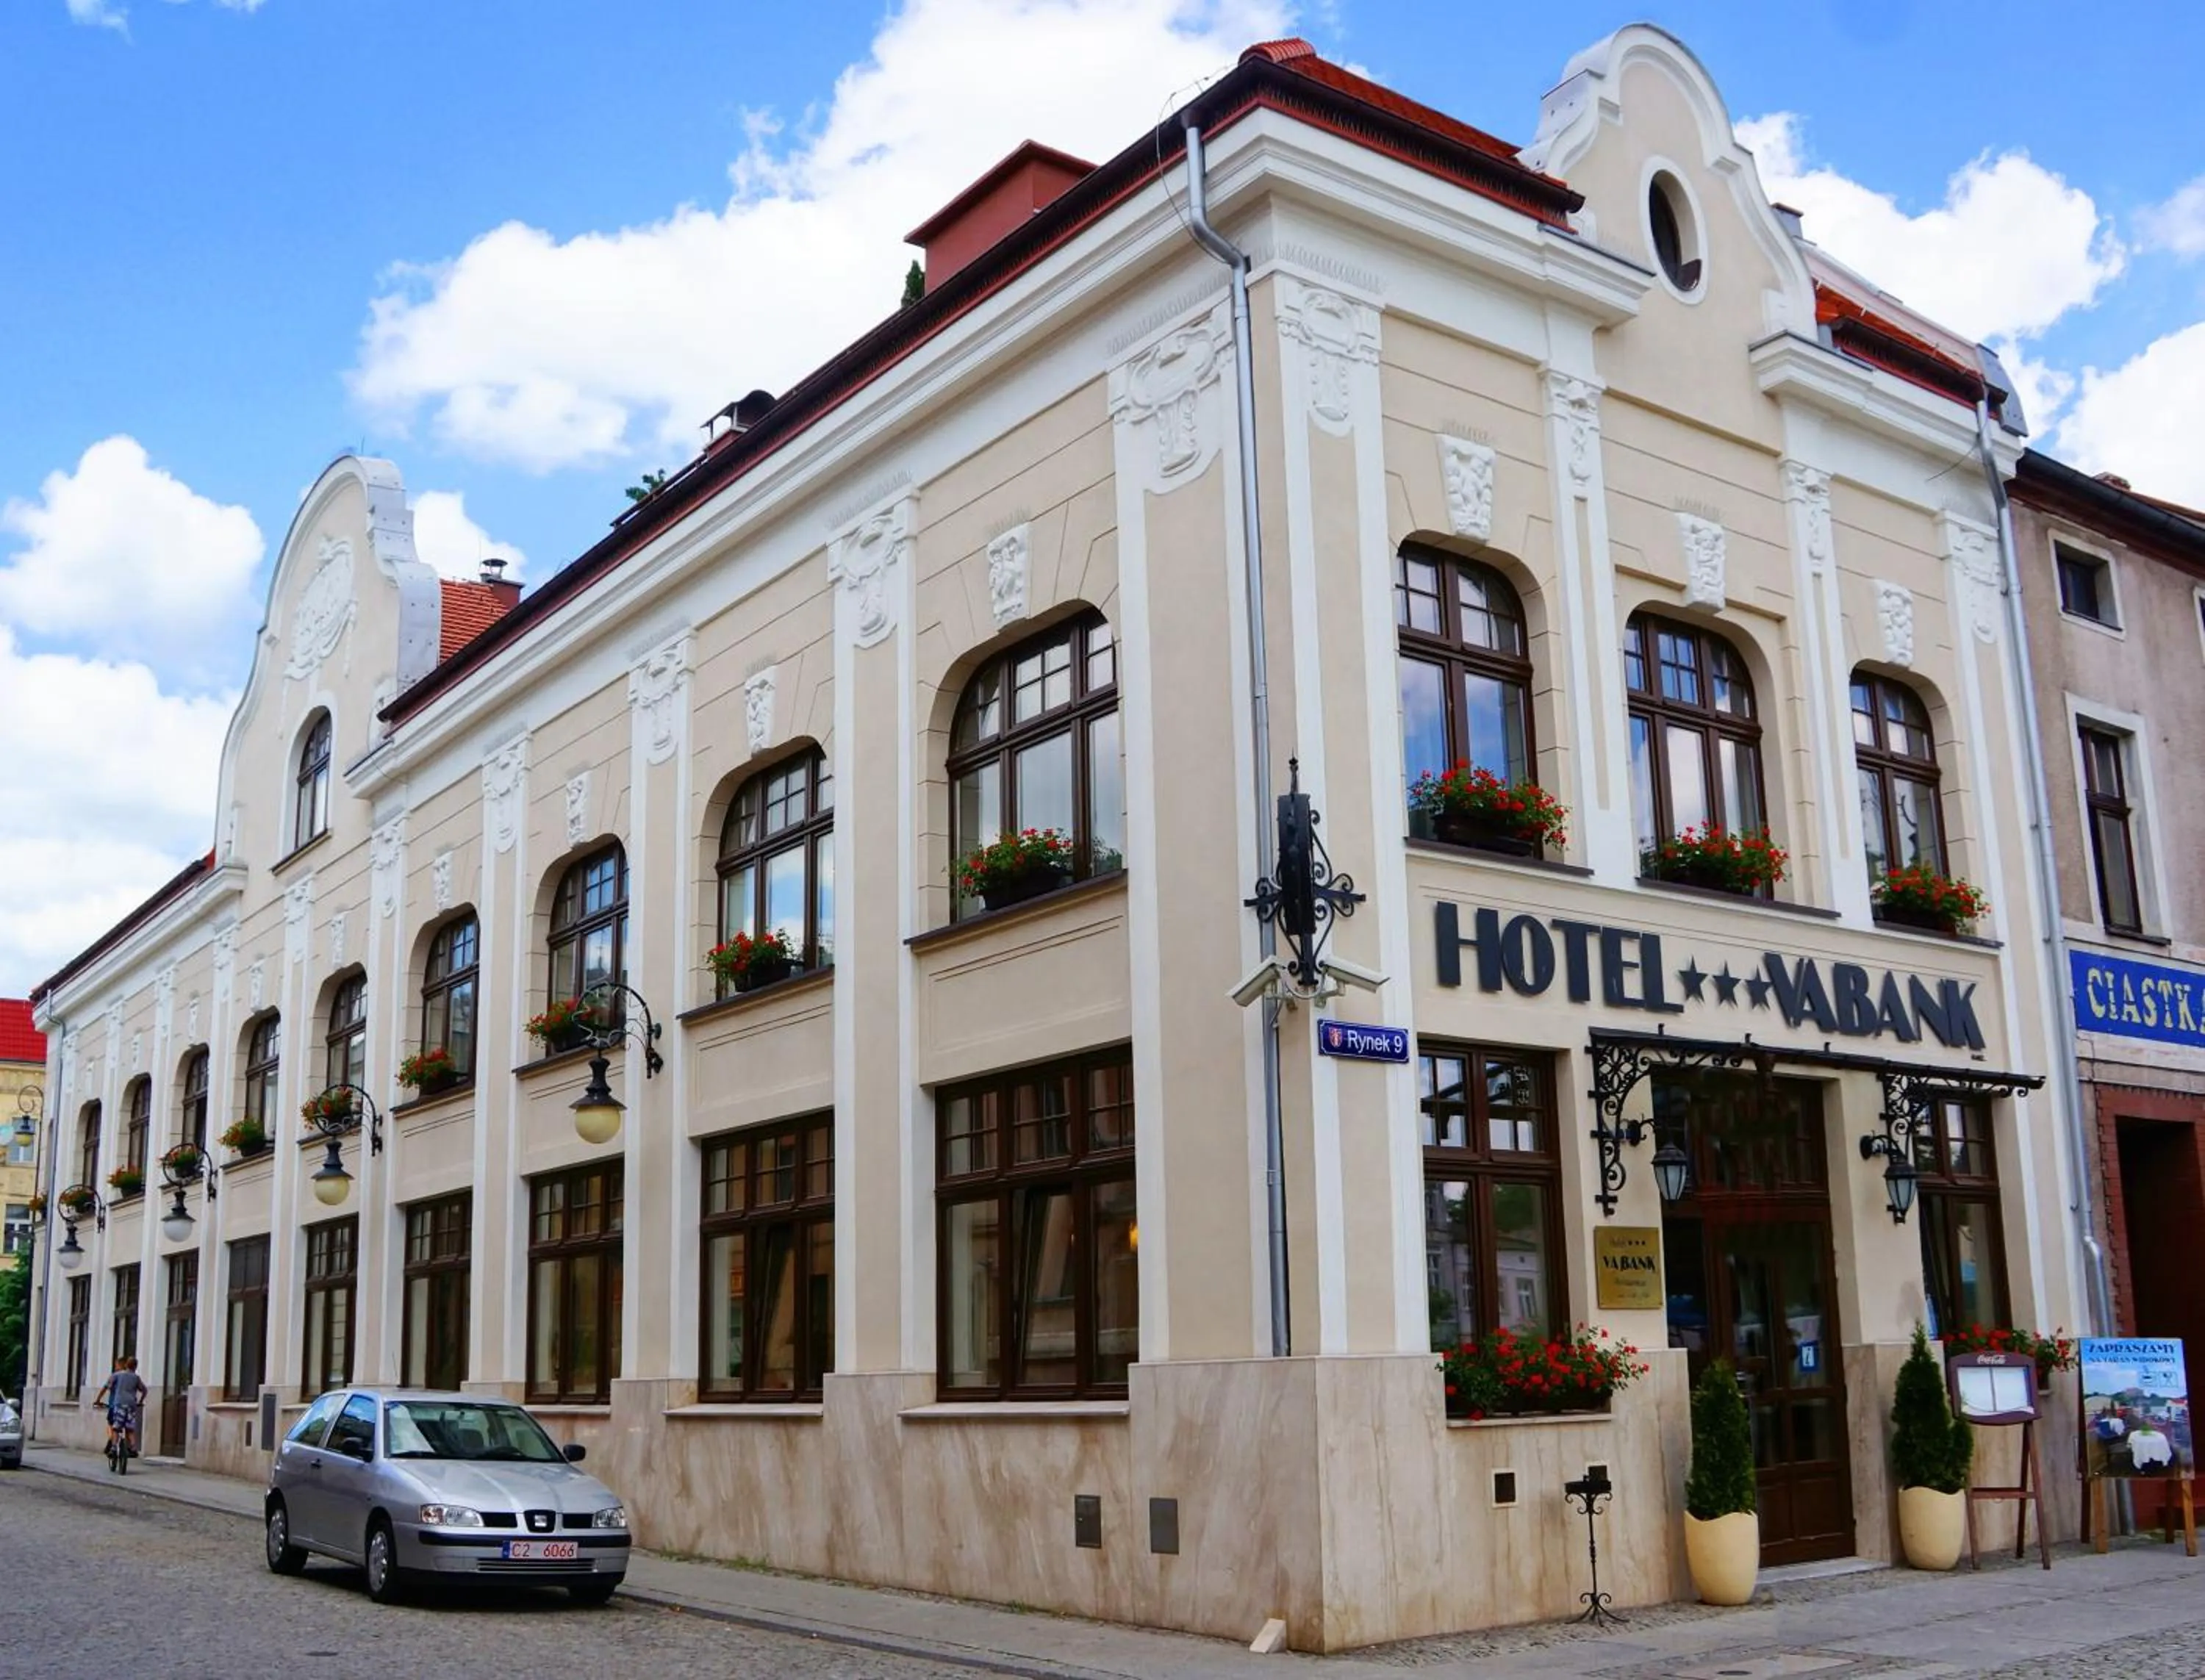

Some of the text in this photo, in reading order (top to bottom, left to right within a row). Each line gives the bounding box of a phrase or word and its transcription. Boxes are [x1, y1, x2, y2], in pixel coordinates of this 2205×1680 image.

[1436, 901, 1986, 1050] HOTEL VABANK
[2087, 967, 2205, 1035] CIASTK
[1347, 1030, 1403, 1054] Rynek 9
[1603, 1255, 1656, 1272] VABANK
[2089, 1343, 2176, 1354] ZAPRASZAMY
[512, 1543, 530, 1557] C2
[543, 1543, 574, 1557] 6066
